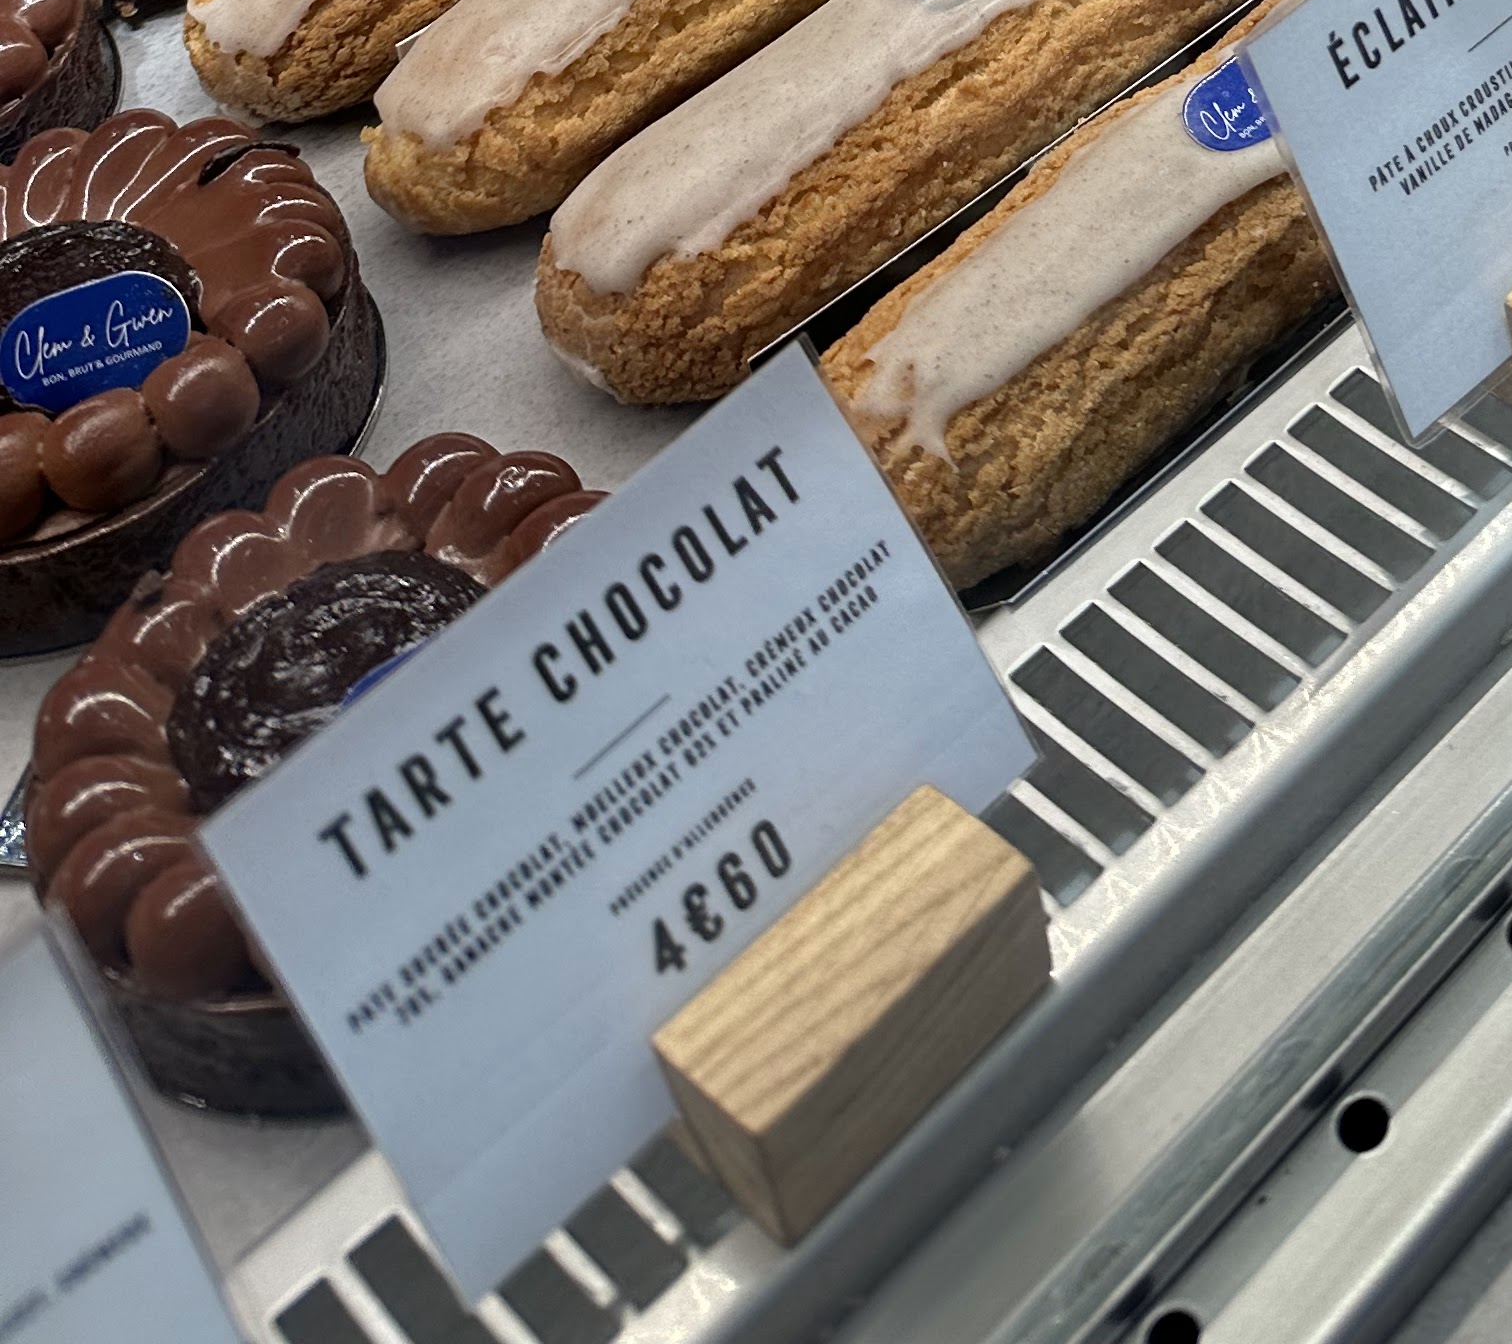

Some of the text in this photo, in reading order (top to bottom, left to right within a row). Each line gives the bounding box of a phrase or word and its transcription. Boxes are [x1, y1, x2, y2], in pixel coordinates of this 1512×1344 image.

[1367, 154, 1404, 192] PÂTE
[1402, 143, 1416, 164] À
[1414, 108, 1459, 153] CHOUX
[1398, 141, 1455, 196] VANILLE
[1453, 126, 1474, 152] DE
[67, 362, 96, 379] BRUT
[104, 340, 163, 366] GOURMAND
[80, 324, 96, 348] &
[816, 539, 890, 613] CHOCOLAT
[318, 447, 797, 877] TARTE CHOCOLAT
[596, 762, 680, 844] CHOCOLAT
[715, 709, 739, 737] ET
[739, 647, 806, 715] PRALINÉ
[807, 628, 829, 655] AU
[829, 584, 878, 634] CACAO
[652, 819, 791, 973] 4€60
